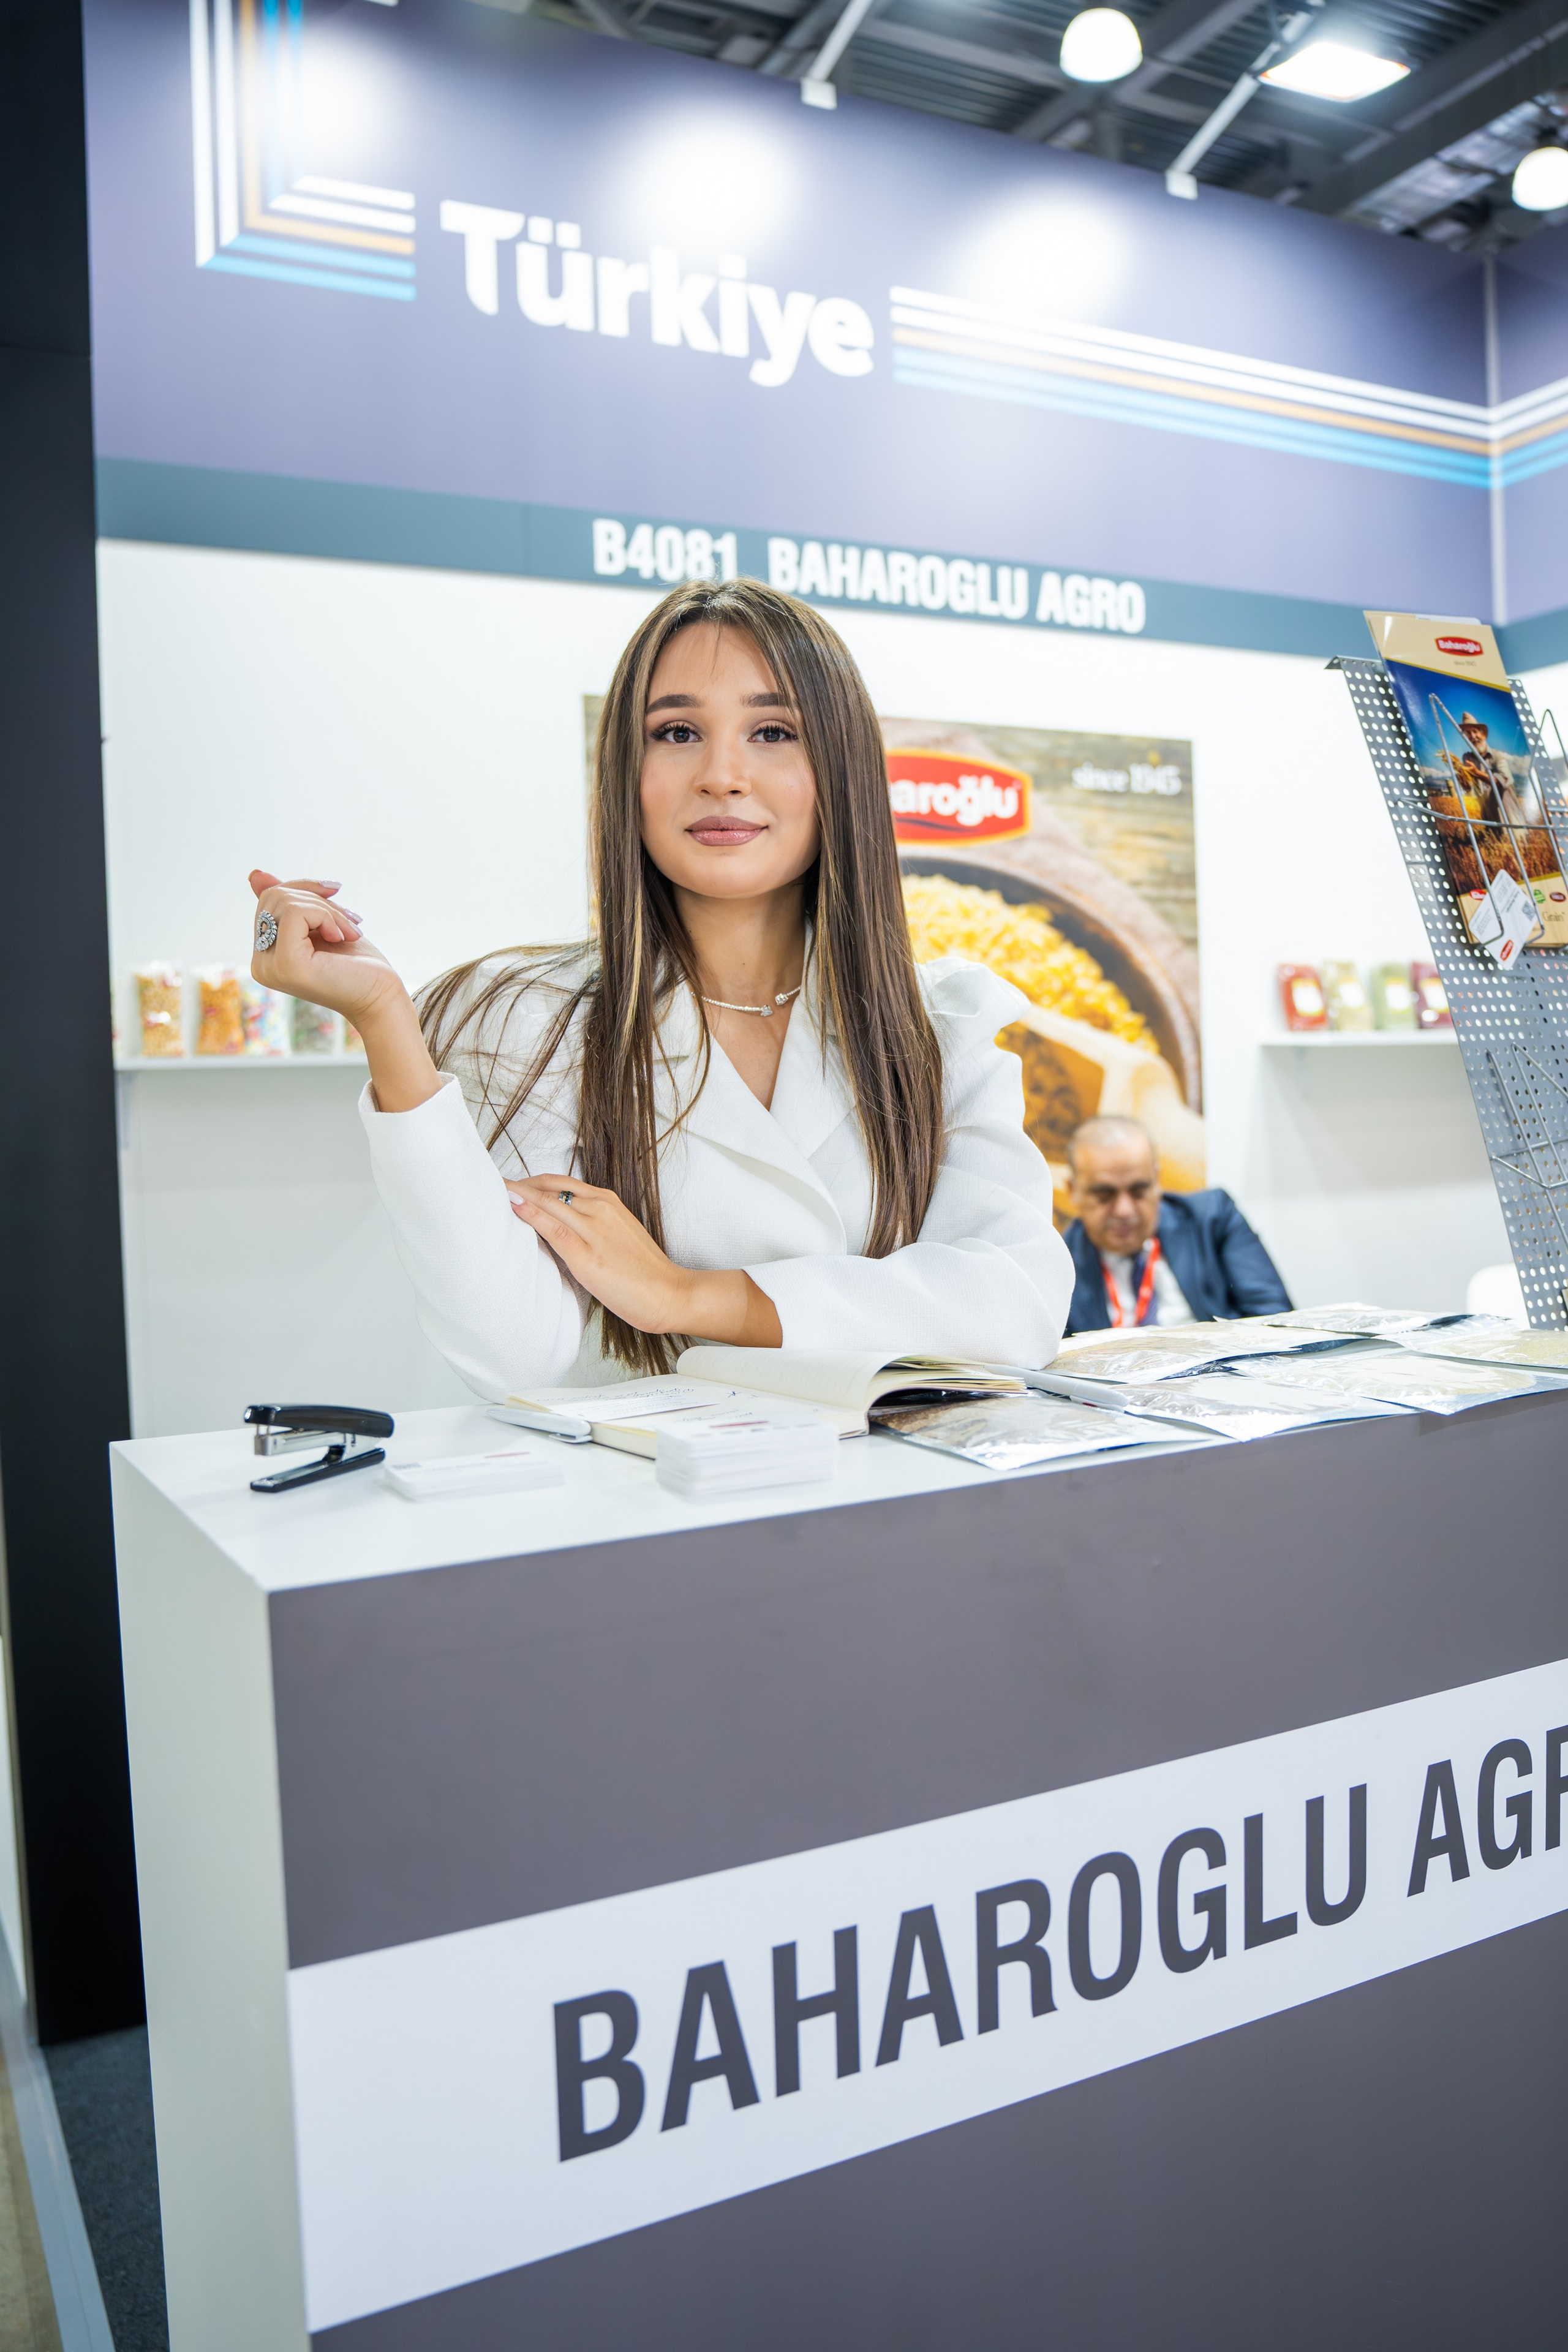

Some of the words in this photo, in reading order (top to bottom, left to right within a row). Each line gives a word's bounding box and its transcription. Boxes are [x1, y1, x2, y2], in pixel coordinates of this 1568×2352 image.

[440, 198, 875, 388] Türkiye
[592, 518, 738, 584] B4081
[767, 537, 1029, 620] BAHAROGLU
[1036, 570, 1146, 634] AGRO
[888, 774, 1019, 827] aroğlu
[552, 1783, 1368, 2163] BAHAROGLU
